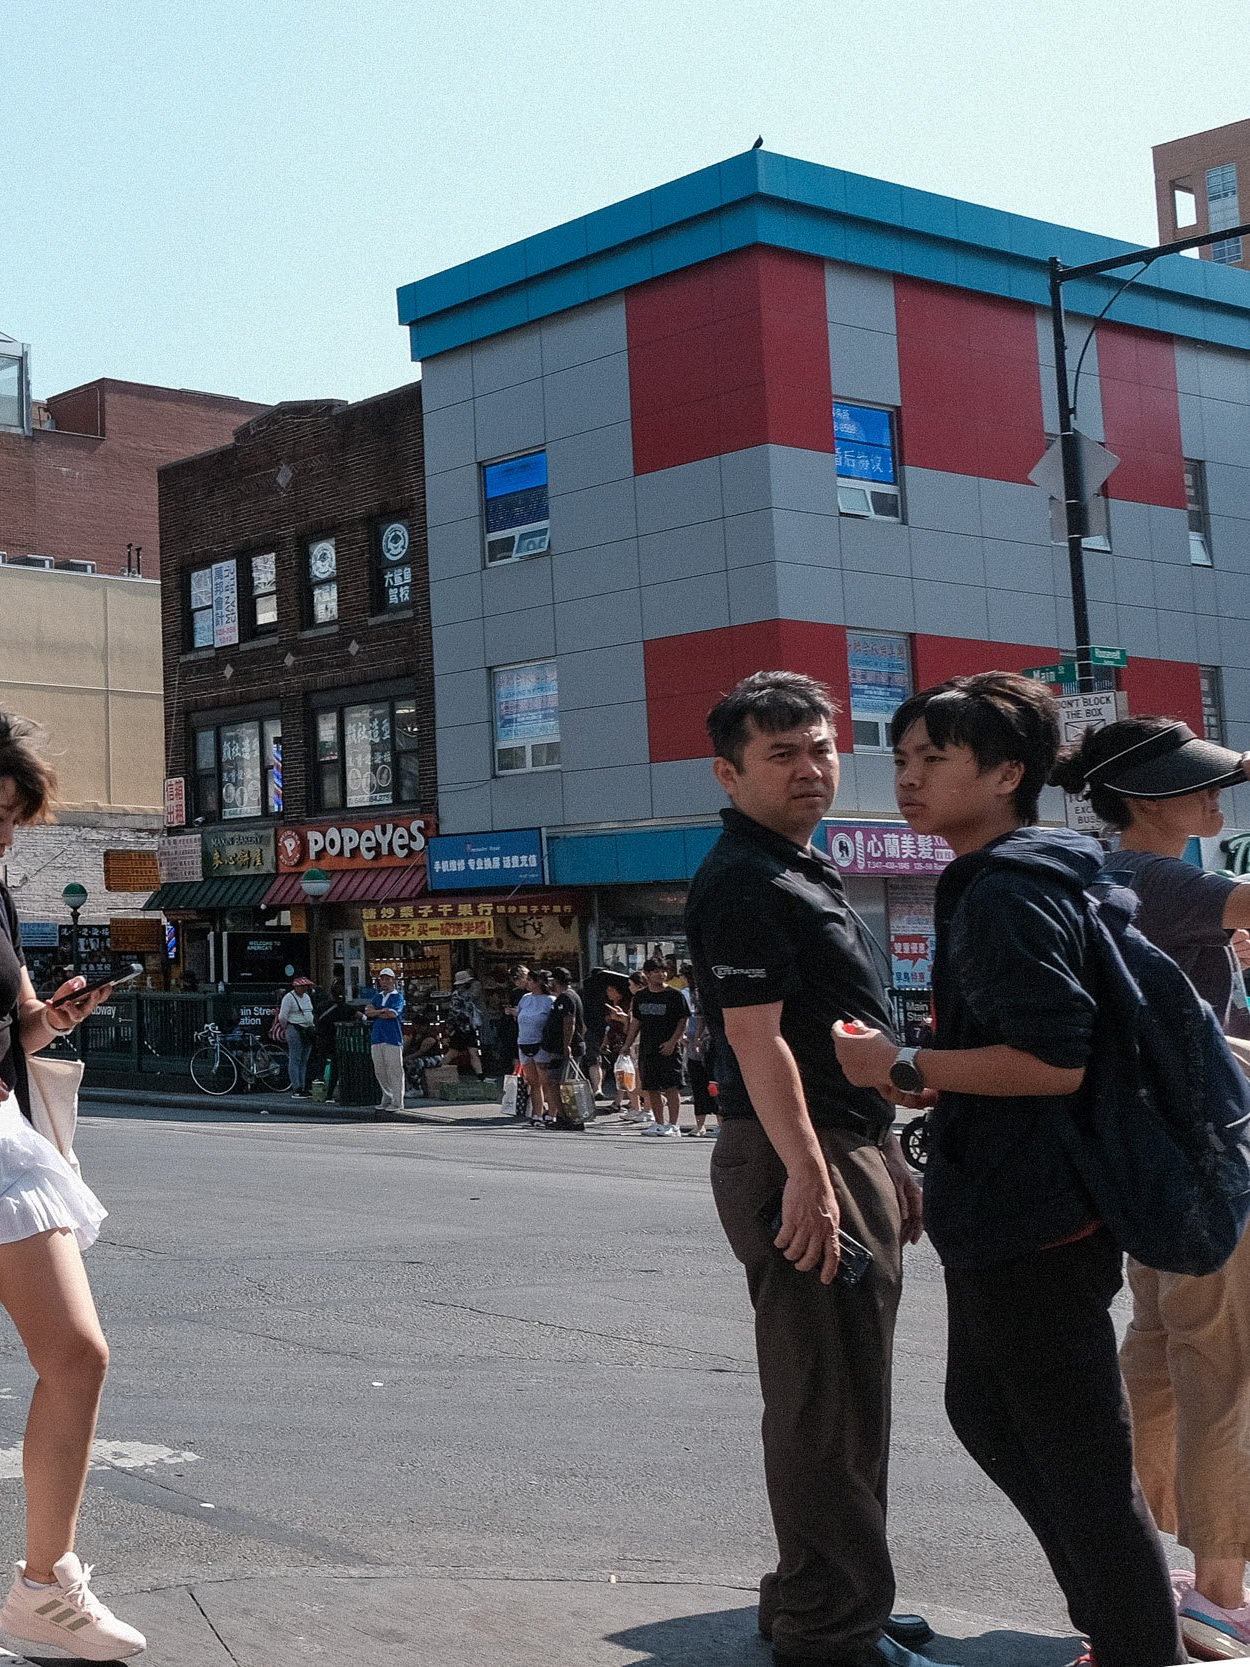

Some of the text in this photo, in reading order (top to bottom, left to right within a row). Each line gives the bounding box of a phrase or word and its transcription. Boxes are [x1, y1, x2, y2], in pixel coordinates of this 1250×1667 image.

[1082, 697, 1111, 707] BLOCK
[1066, 708, 1103, 719] THE BOX
[1075, 806, 1093, 814] EXC
[253, 1007, 276, 1016] Stree
[906, 1001, 929, 1012] Main
[238, 1017, 261, 1025] ation
[914, 1027, 922, 1039] 7
